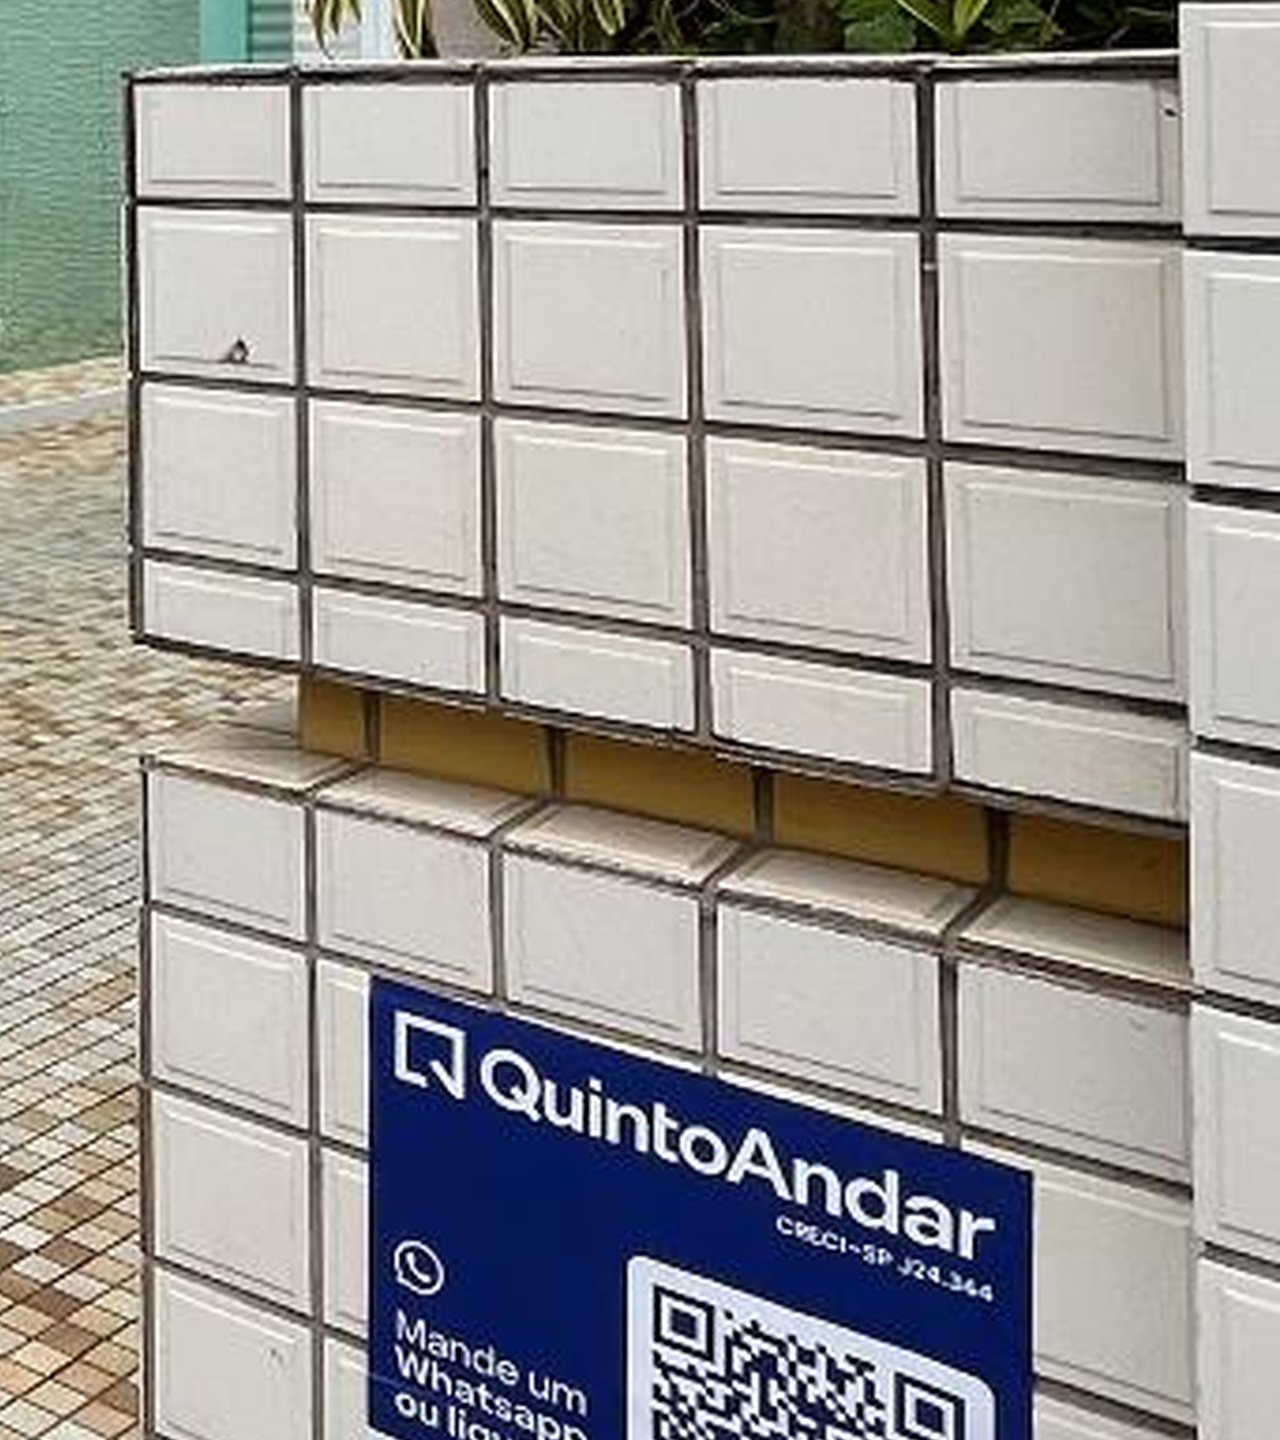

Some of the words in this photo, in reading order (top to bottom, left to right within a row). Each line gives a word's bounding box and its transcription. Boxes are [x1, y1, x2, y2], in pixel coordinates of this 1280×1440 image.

[479, 1049, 997, 1260] QuintoAndar
[394, 1392, 439, 1428] ou
[396, 1308, 520, 1386] Mande
[528, 1370, 588, 1417] um
